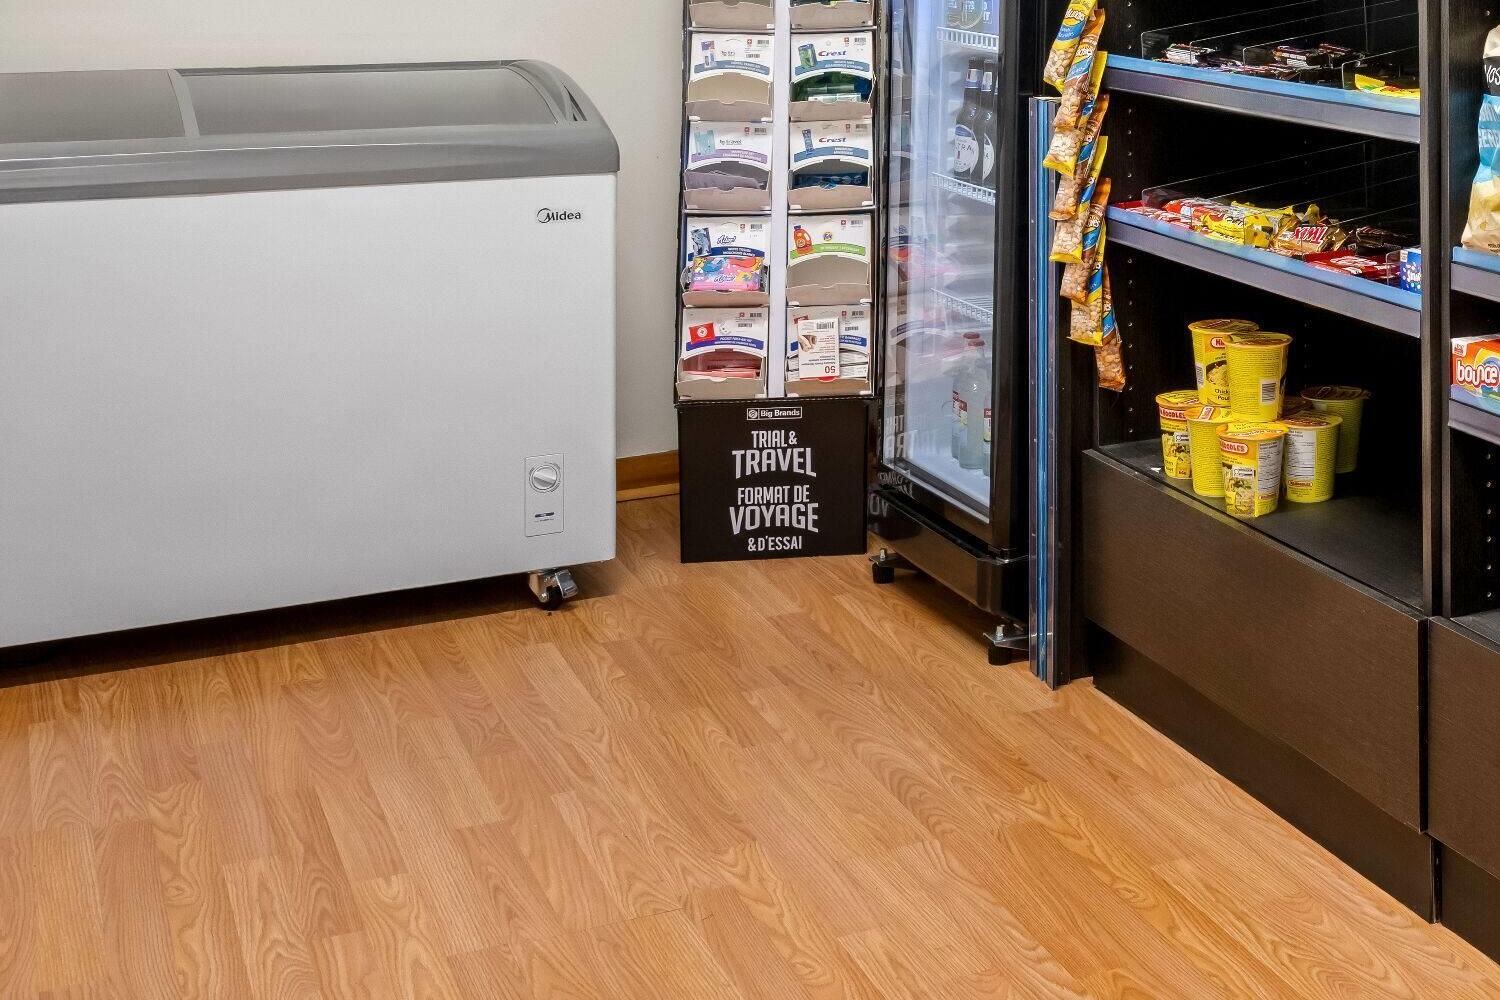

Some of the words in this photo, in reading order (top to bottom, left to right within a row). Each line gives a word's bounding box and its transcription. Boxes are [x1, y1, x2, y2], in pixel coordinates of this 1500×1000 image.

[536, 207, 582, 224] Midea
[1456, 361, 1500, 388] bounce
[760, 410, 773, 418] Big
[774, 409, 800, 417] Brands
[751, 430, 787, 448] TRIAL
[788, 430, 798, 445] &
[731, 447, 817, 479] TRAVEL
[737, 485, 790, 505] FORMAT
[794, 485, 810, 503] DE
[729, 502, 819, 535] VOYAGE
[758, 535, 802, 551] D'ESSAI
